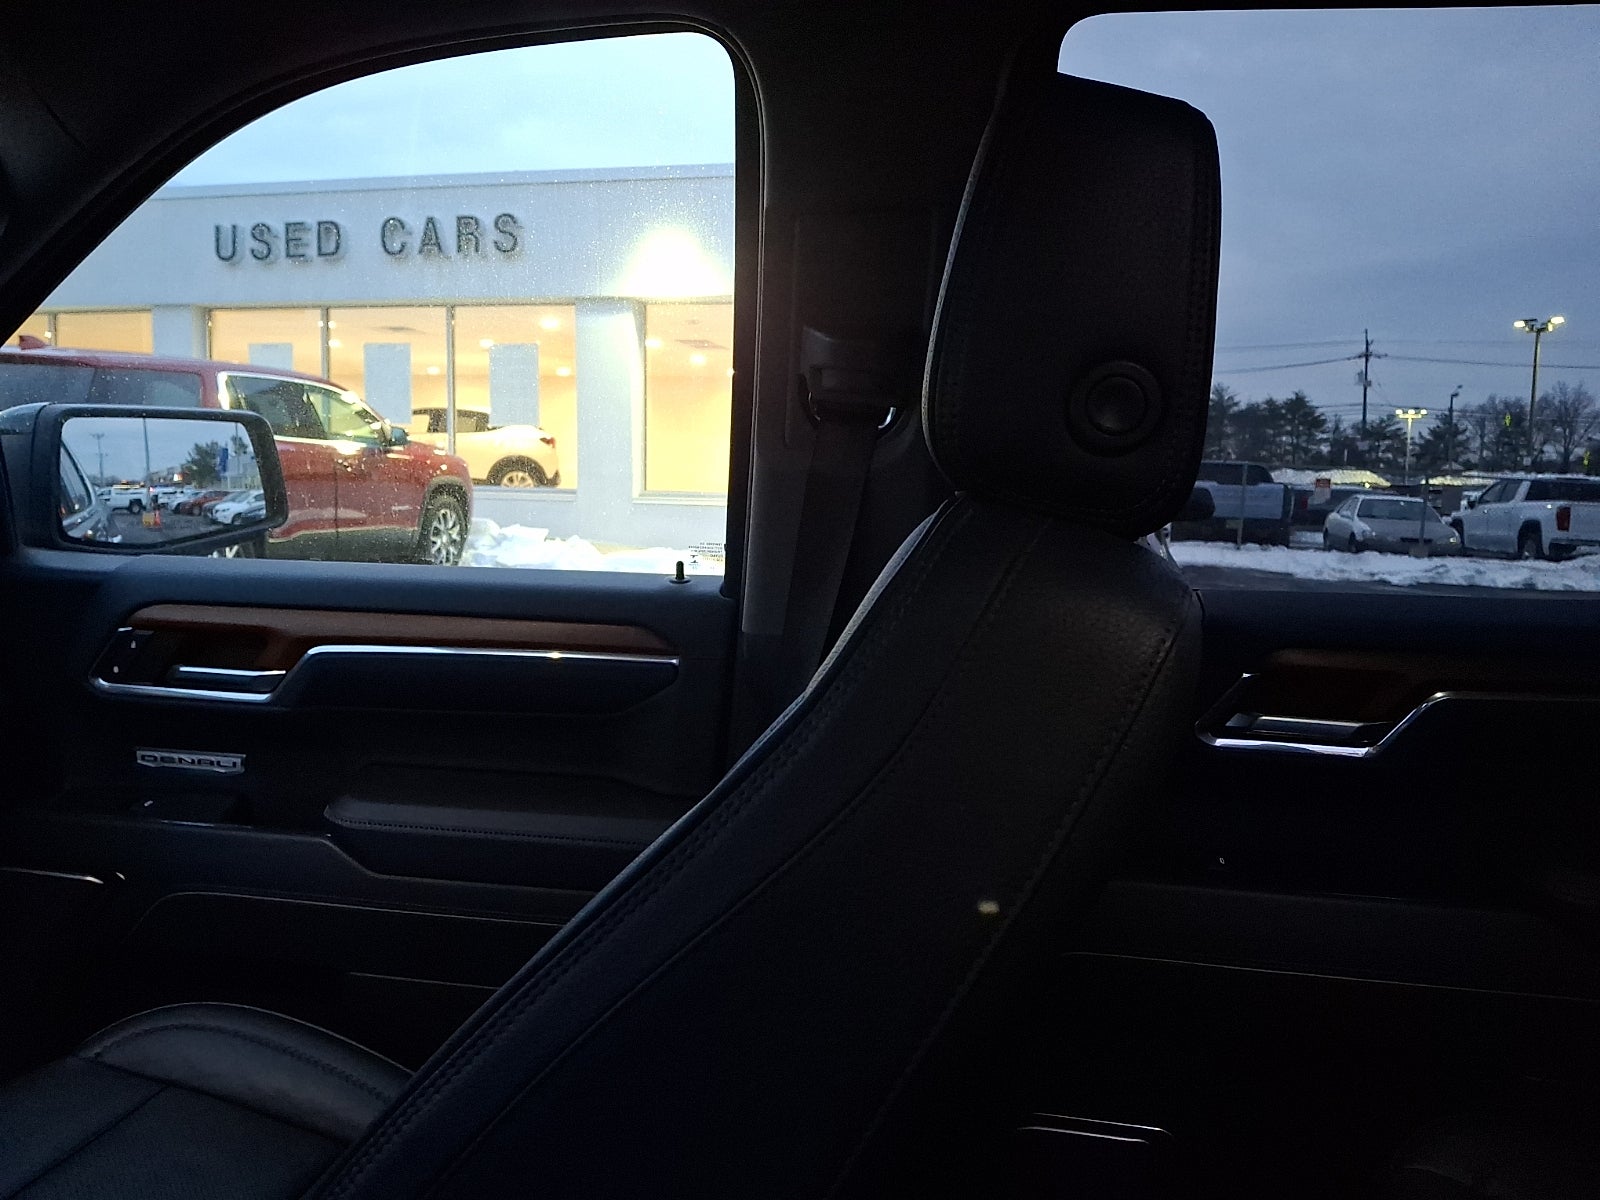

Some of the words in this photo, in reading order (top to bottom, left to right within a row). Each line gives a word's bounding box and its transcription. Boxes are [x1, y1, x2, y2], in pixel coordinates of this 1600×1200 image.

[213, 220, 342, 263] USED
[380, 212, 520, 257] CARS
[140, 753, 238, 769] DENALI
